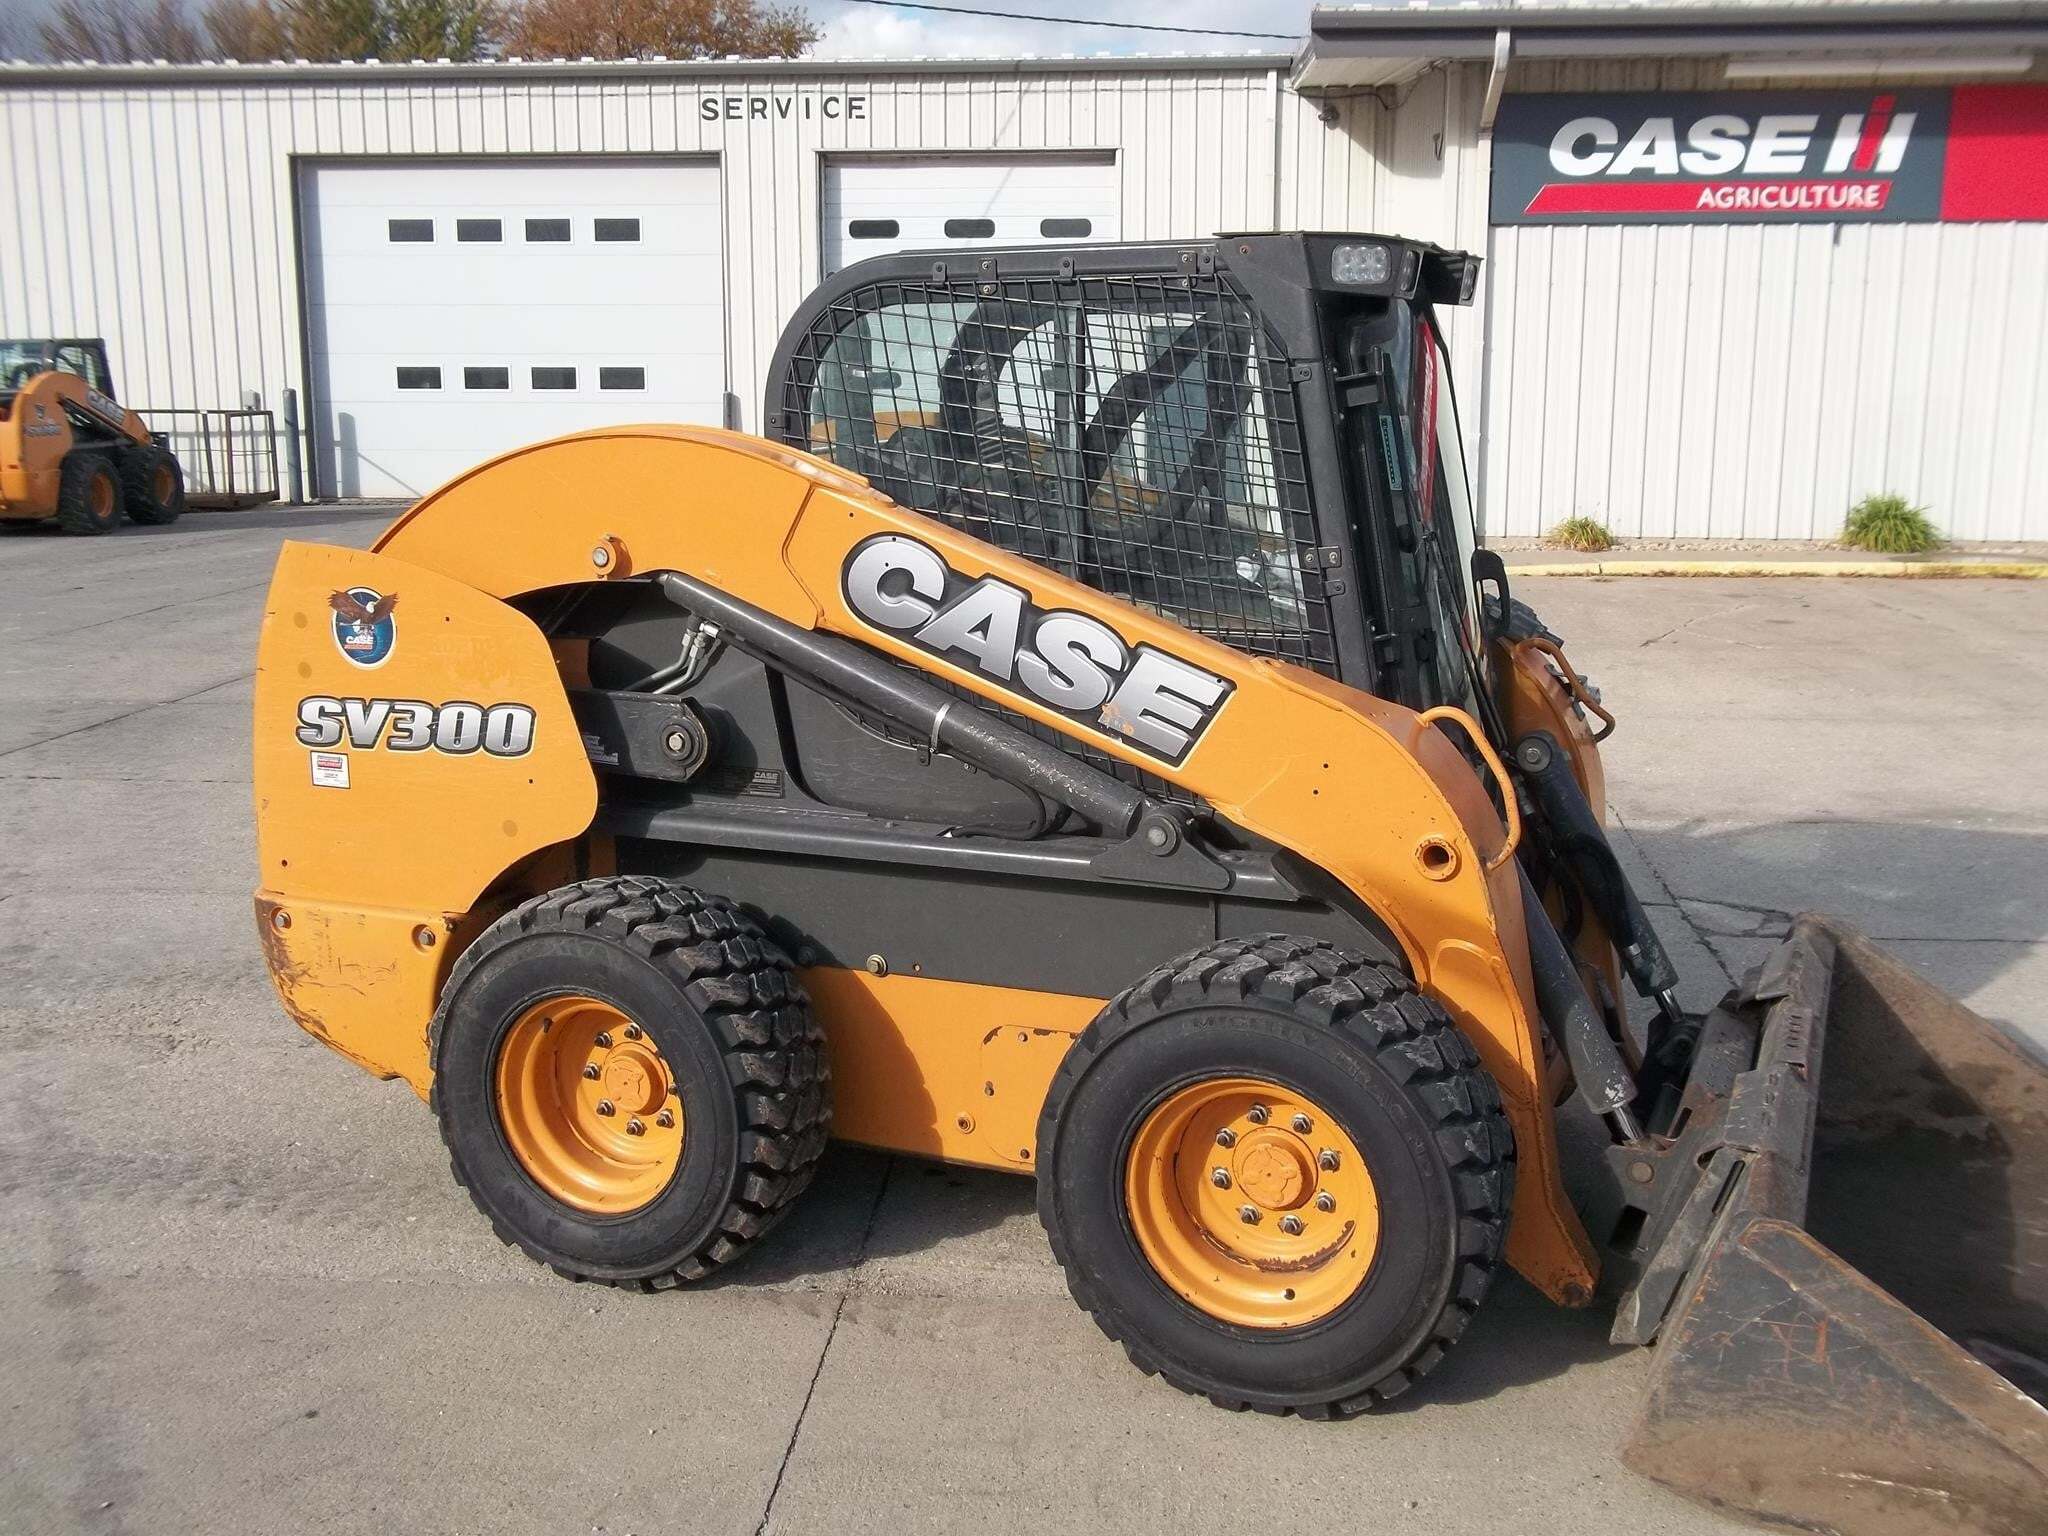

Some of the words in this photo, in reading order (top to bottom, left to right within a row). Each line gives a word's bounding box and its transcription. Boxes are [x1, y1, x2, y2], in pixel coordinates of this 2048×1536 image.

[701, 96, 866, 121] SERVICE
[1549, 113, 1820, 176] CASE
[1696, 184, 1880, 210] AGRICULTURE
[843, 533, 1234, 765] CASE
[297, 695, 537, 757] SV300
